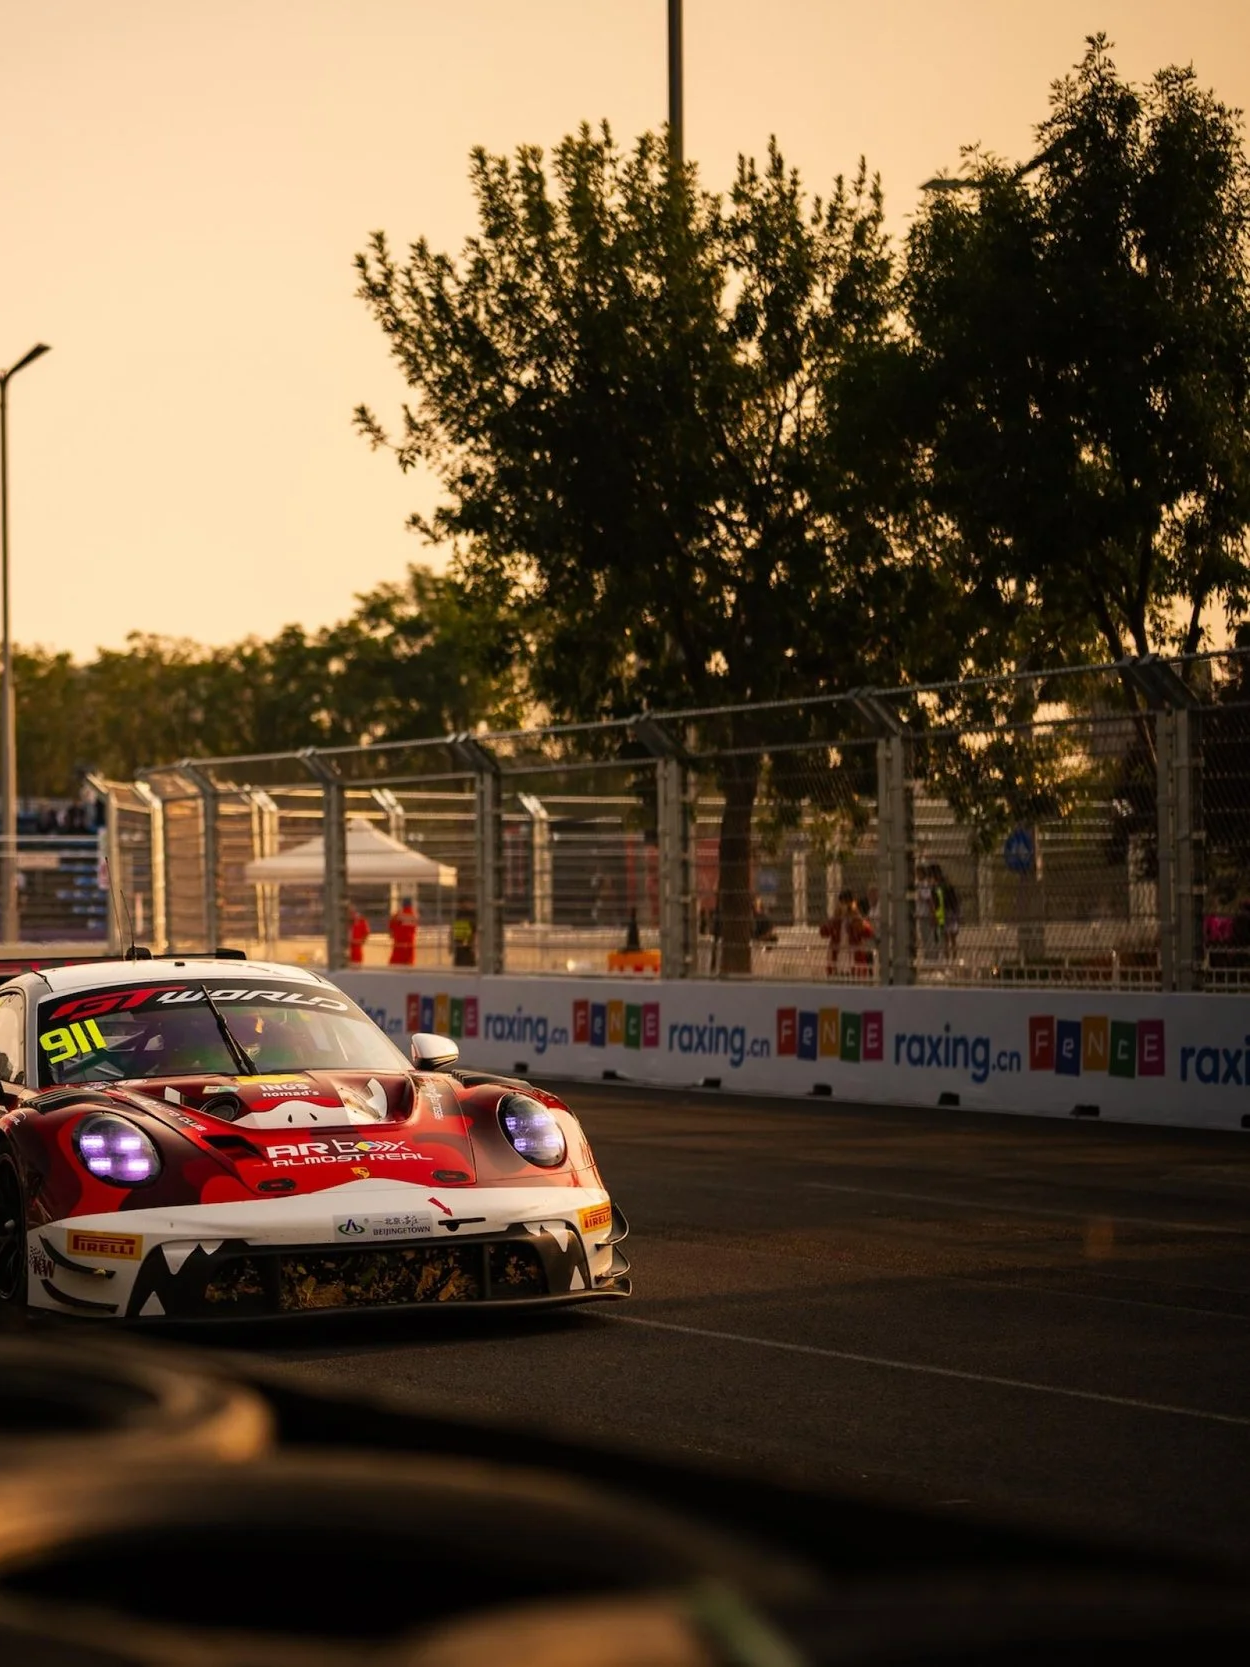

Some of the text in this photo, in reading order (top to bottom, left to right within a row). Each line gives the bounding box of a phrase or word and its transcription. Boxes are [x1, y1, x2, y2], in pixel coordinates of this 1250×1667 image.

[39, 1018, 107, 1065] 911
[484, 1004, 569, 1054] raxing.cn
[668, 1014, 771, 1068] raxing.cn
[894, 1021, 1022, 1083] raxing.cn
[262, 1090, 320, 1098] nomad's
[178, 1116, 208, 1132] CLUB
[273, 1152, 434, 1168] ALMOST REAL
[584, 1206, 611, 1229] PIRELLI
[73, 1235, 136, 1256] PIRELLI
